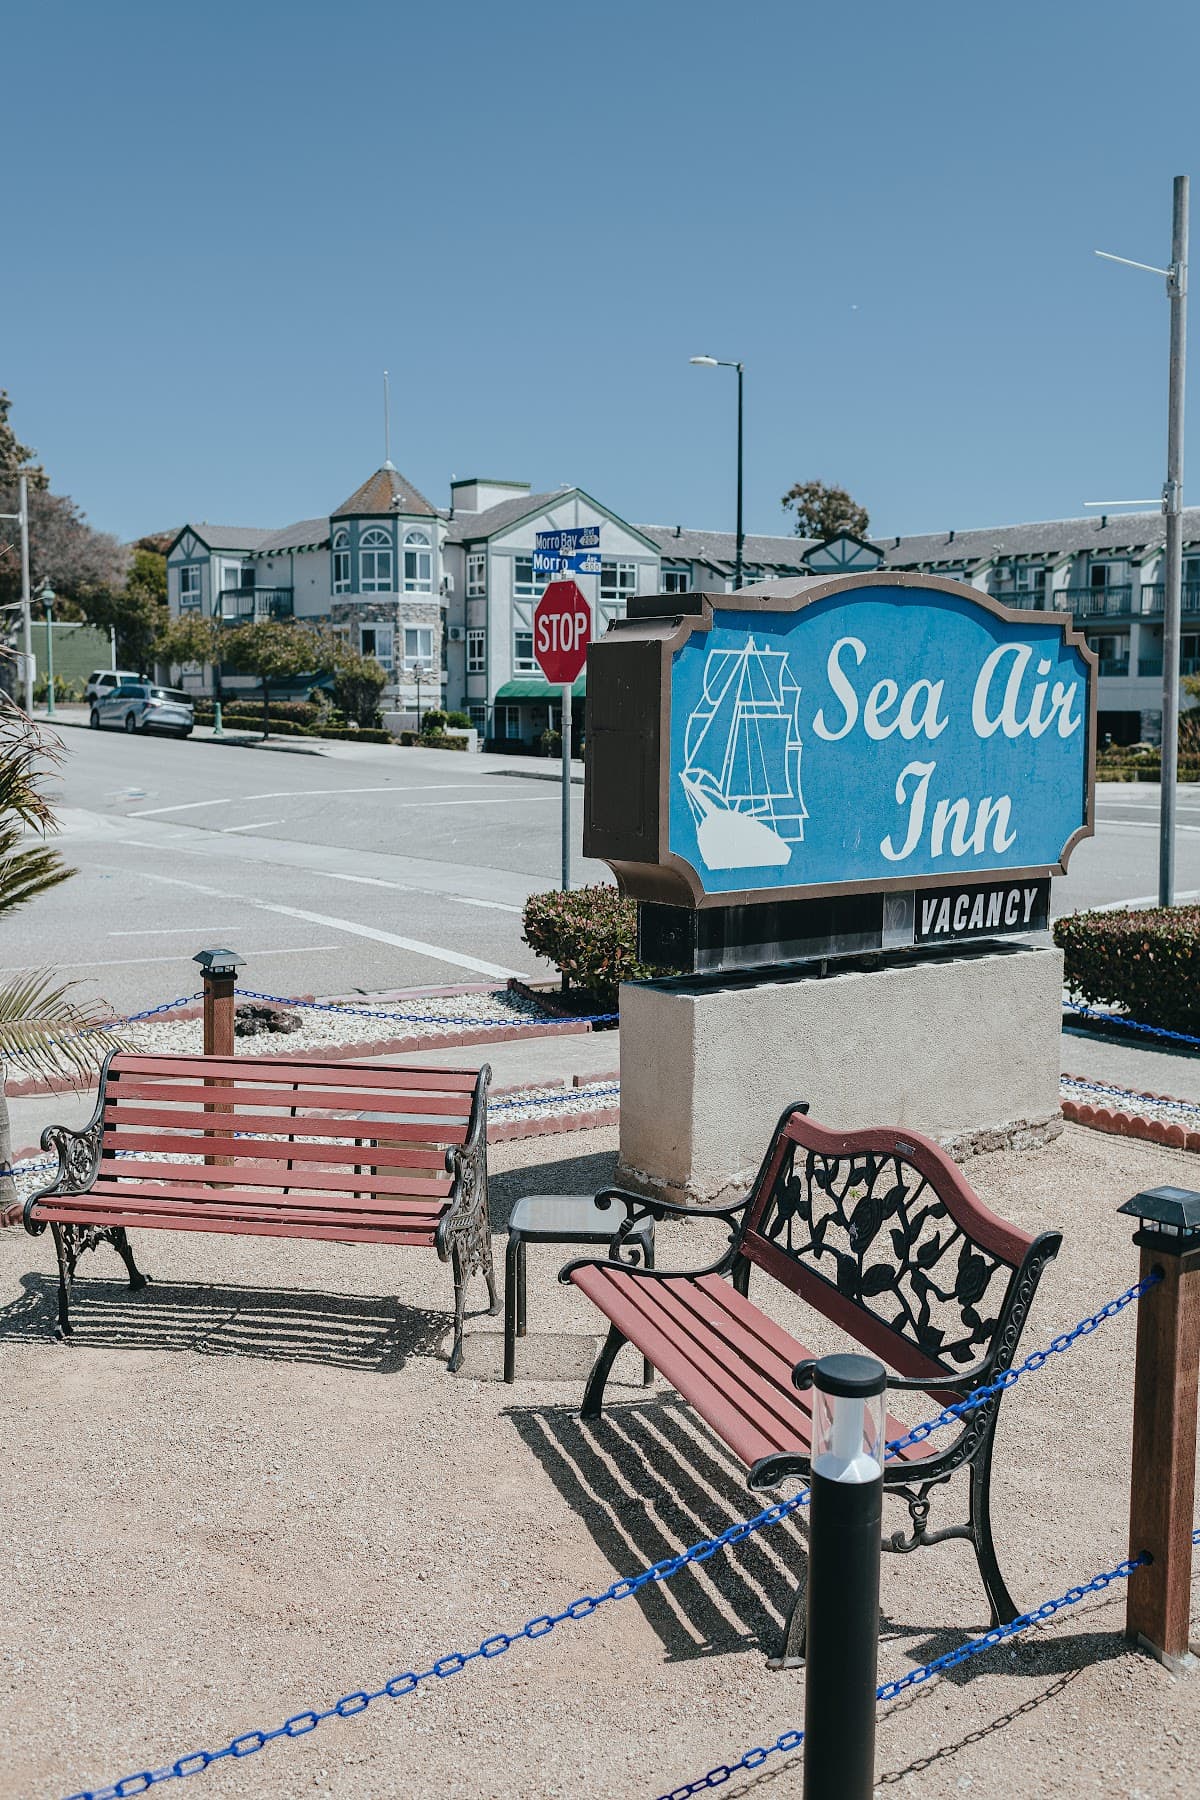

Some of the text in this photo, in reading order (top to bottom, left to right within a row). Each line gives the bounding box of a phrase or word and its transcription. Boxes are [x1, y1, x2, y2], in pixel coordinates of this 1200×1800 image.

[533, 553, 568, 570] Morro
[536, 528, 595, 551] Morro Bay Blvd
[538, 612, 587, 653] STOP
[812, 636, 1081, 741] Sea Air
[879, 760, 1017, 862] Inn
[920, 887, 1039, 935] VACANCY
